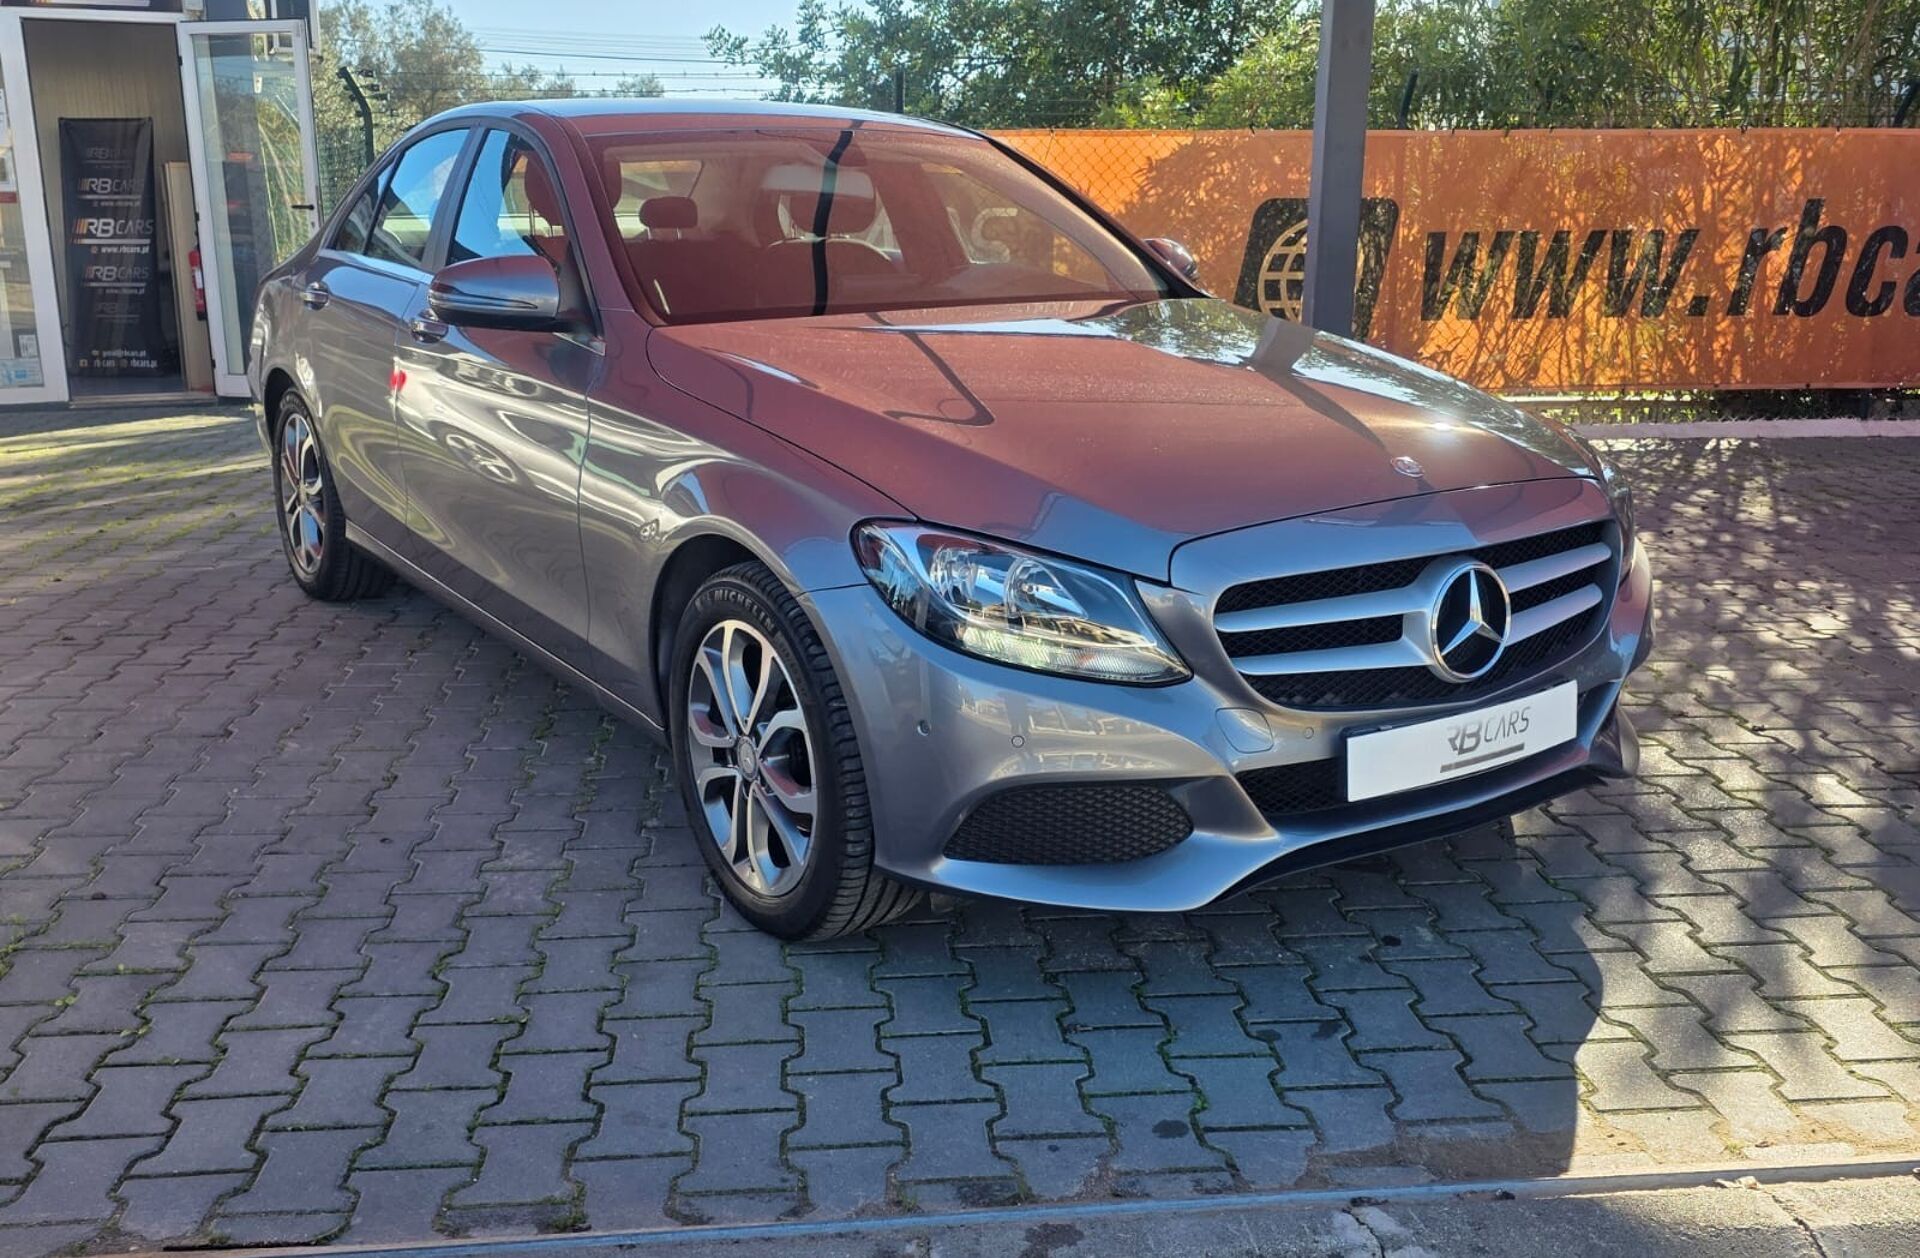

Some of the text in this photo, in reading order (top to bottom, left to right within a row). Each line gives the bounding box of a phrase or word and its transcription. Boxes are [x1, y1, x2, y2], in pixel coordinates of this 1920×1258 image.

[84, 177, 112, 193] RB
[82, 217, 154, 237] RB CARS
[101, 244, 150, 254] www.rbcars.pt
[1420, 198, 1920, 322] www.rbc
[91, 265, 150, 281] RB CARS
[713, 588, 776, 632] MICHELIN
[1446, 706, 1532, 756] RB CARS
